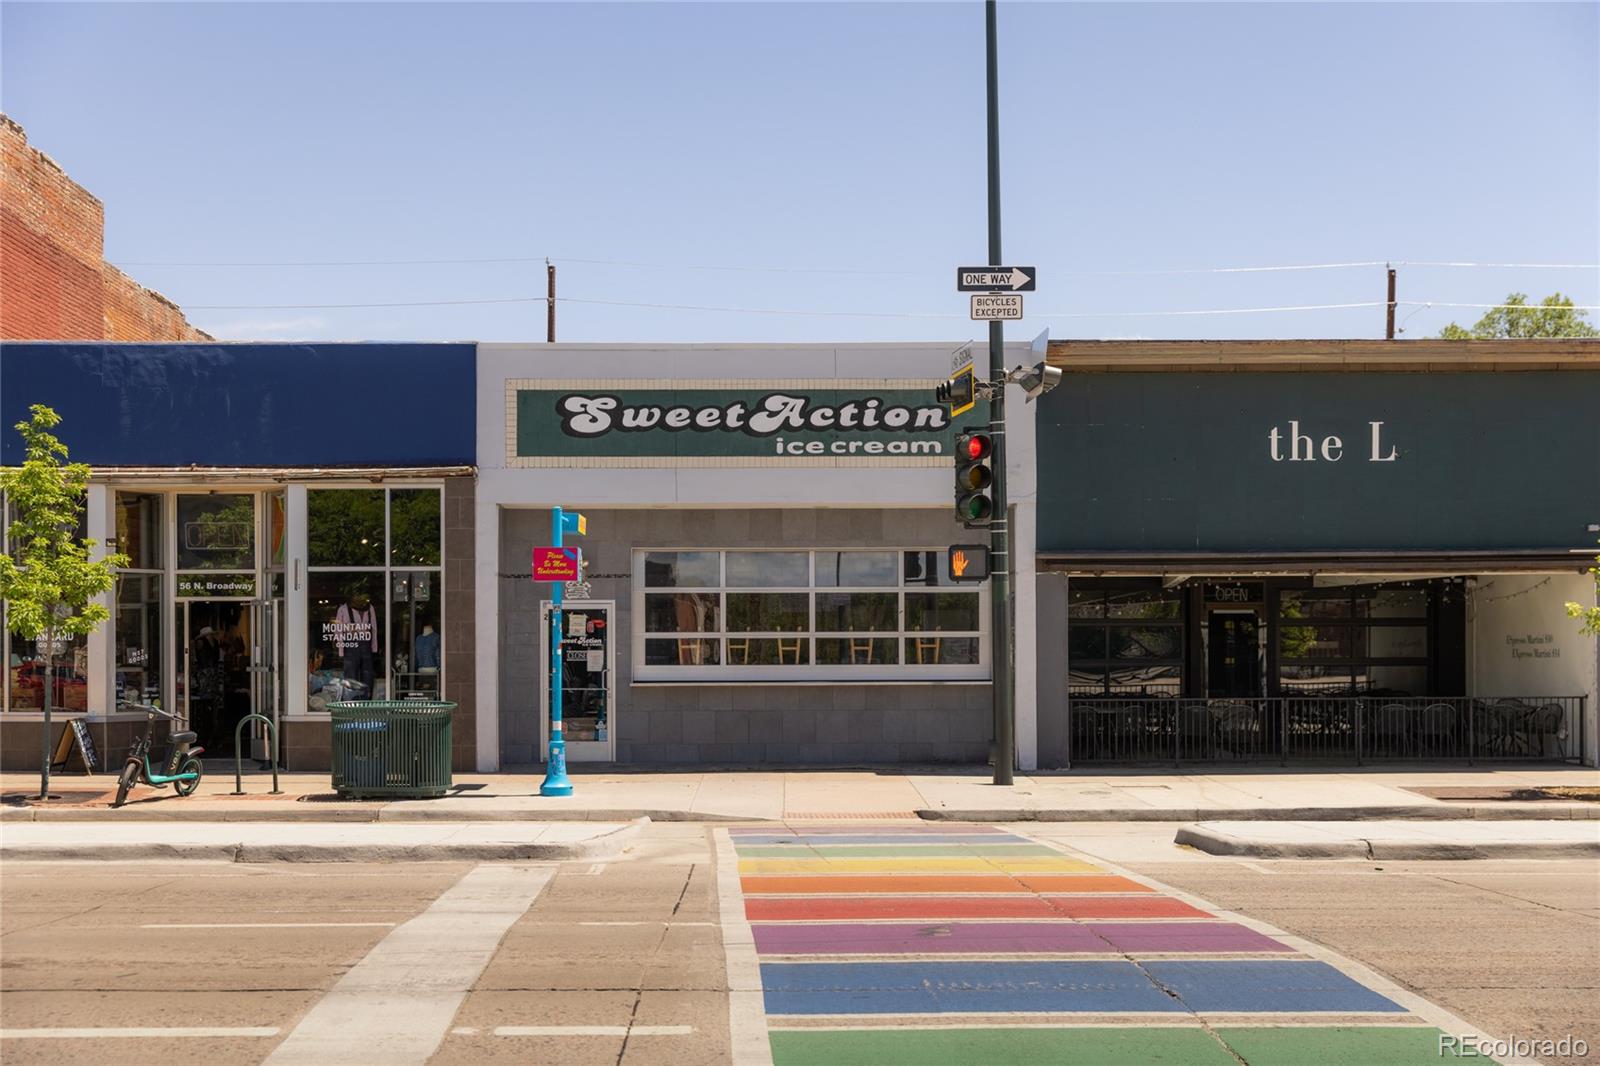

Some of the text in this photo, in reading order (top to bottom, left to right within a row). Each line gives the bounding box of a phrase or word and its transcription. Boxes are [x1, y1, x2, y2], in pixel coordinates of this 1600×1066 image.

[965, 274, 1013, 285] ONE WAY
[976, 298, 1017, 306] BICYCLES
[975, 308, 1018, 317] EXCEPTED
[563, 394, 947, 433] Sweet Action
[775, 437, 942, 454] ice cream
[1268, 420, 1397, 462] the L
[187, 525, 248, 547] OPEN
[180, 582, 191, 590] 56
[206, 582, 253, 591] Broadway
[1216, 588, 1248, 602] OPEN
[322, 623, 372, 634] MOUNTAIN
[322, 631, 372, 642] STANDARD
